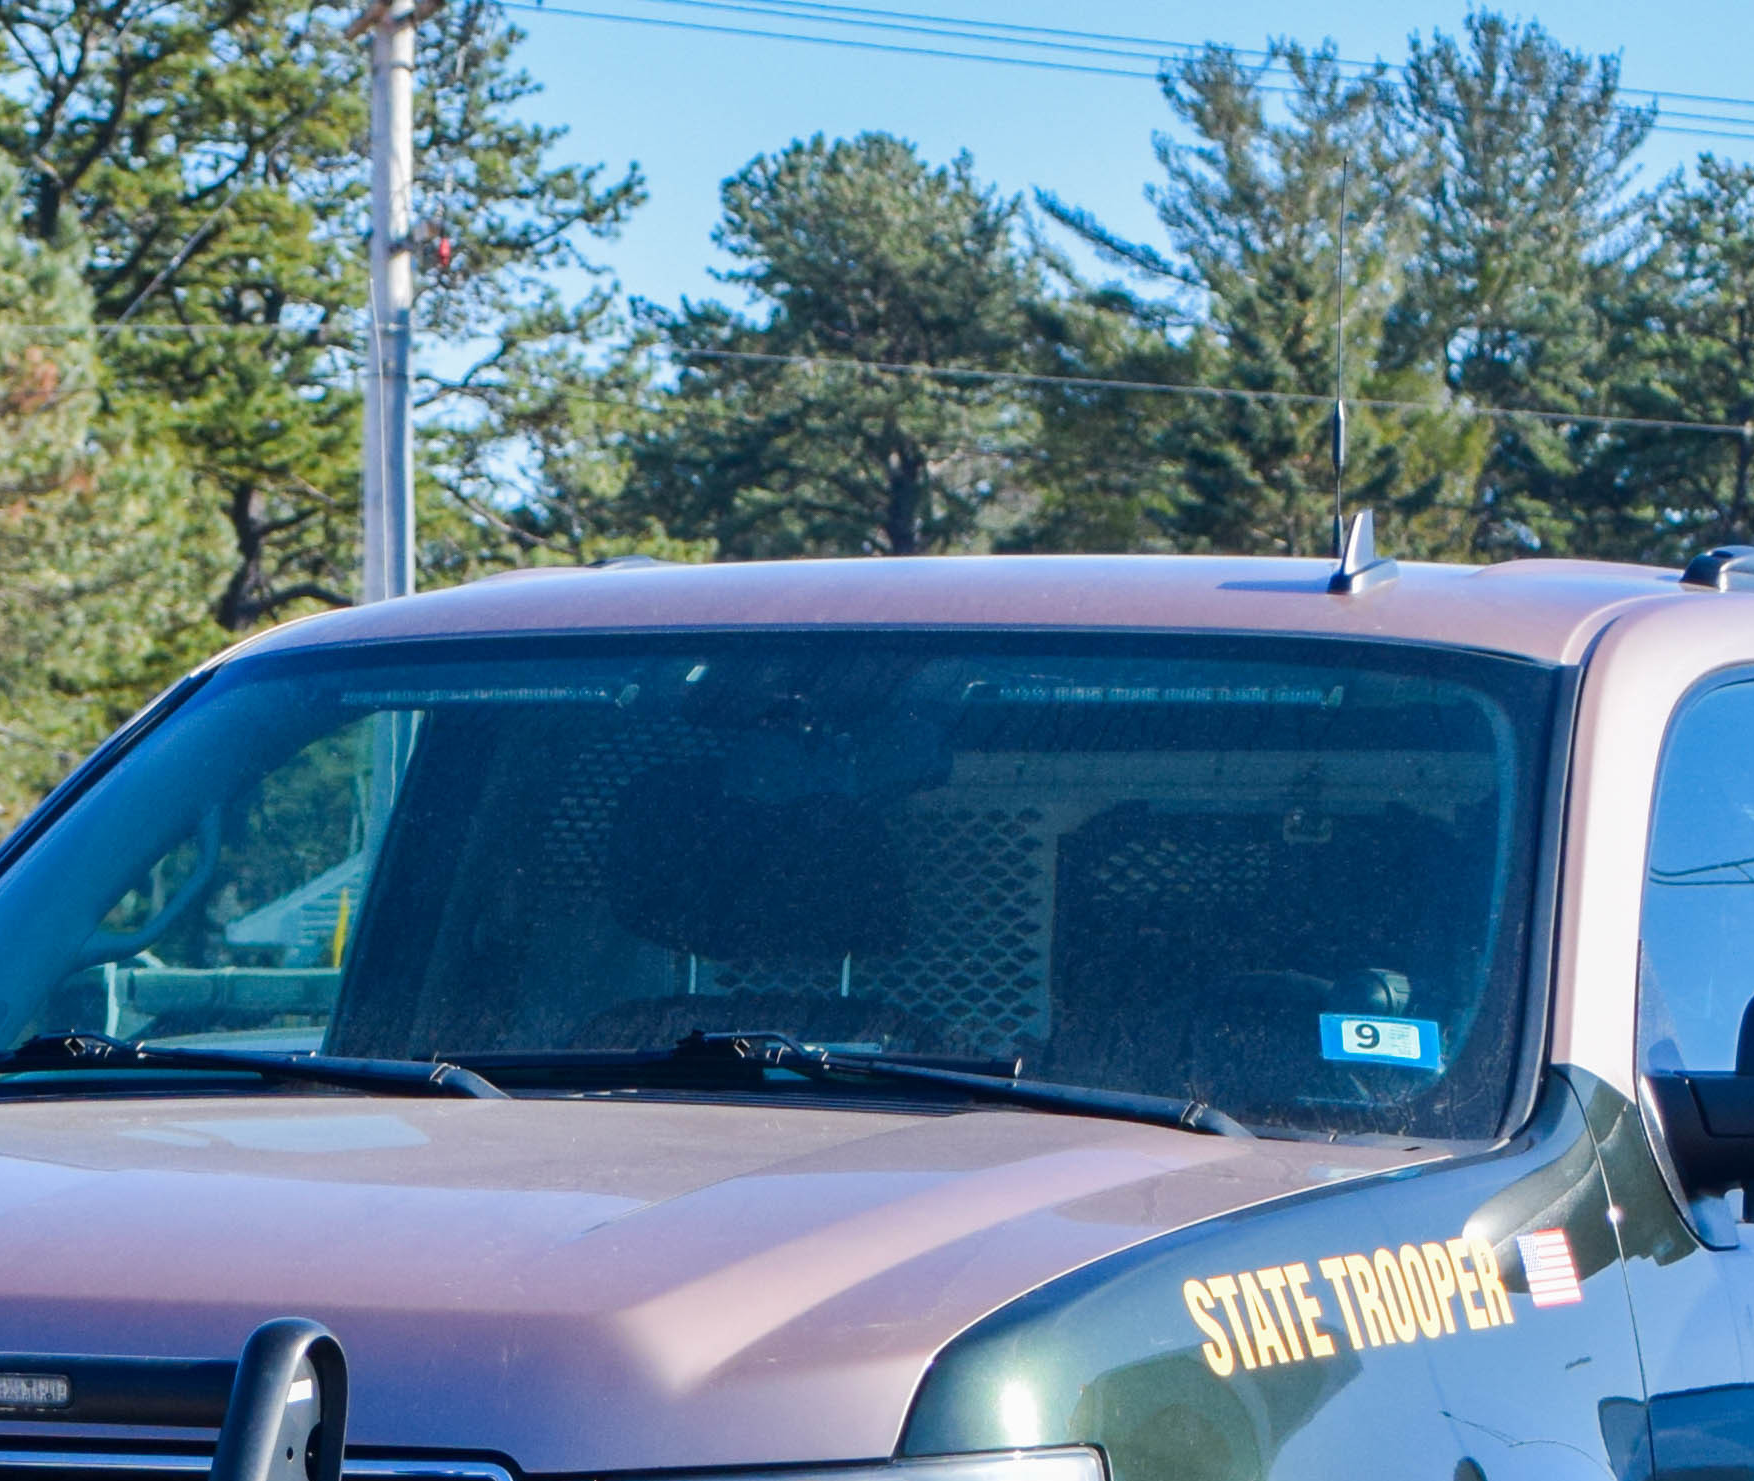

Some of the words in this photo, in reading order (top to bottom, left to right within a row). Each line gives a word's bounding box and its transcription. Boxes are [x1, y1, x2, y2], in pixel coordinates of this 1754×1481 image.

[1354, 1023, 1380, 1049] 9
[1182, 1262, 1335, 1377] STATE
[1318, 1236, 1514, 1350] TROOPER
